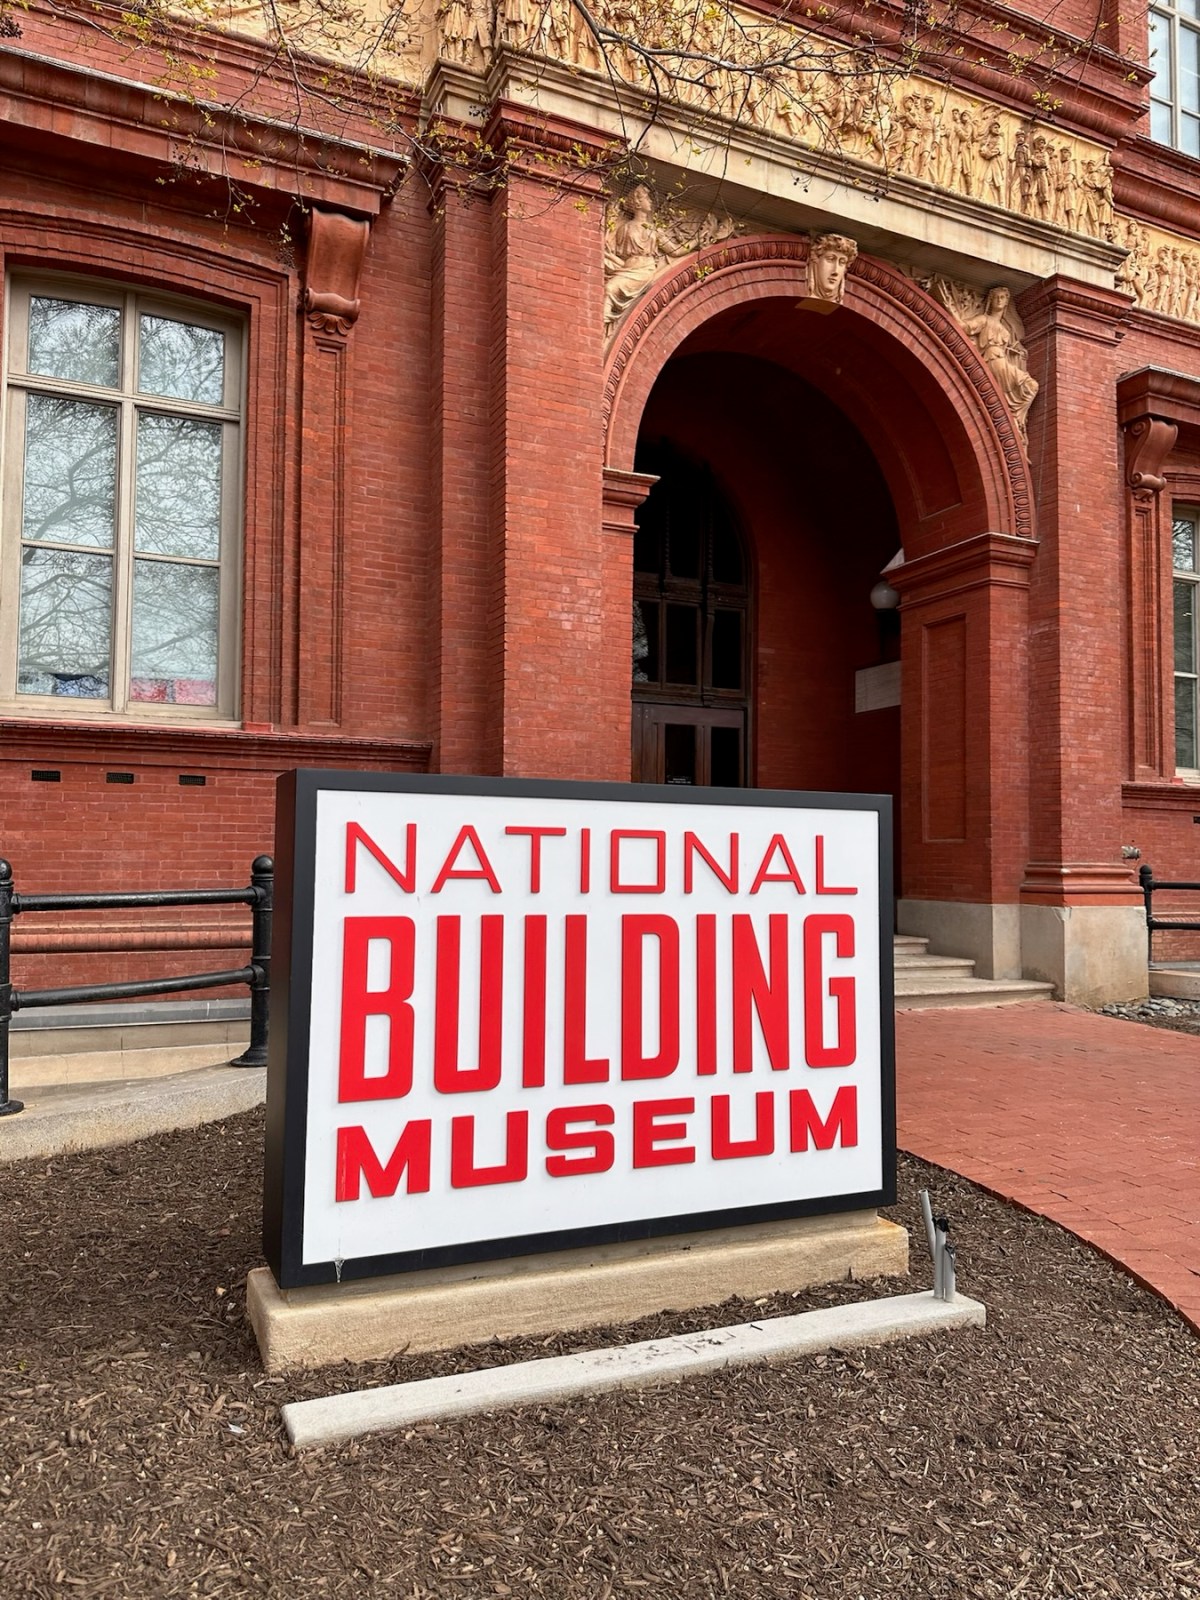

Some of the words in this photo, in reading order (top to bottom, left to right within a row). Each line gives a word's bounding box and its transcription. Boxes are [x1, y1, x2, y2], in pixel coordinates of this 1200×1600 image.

[344, 821, 858, 895] NATIONAL
[337, 913, 857, 1104] BUILDING
[335, 1085, 858, 1203] MUSEUM
